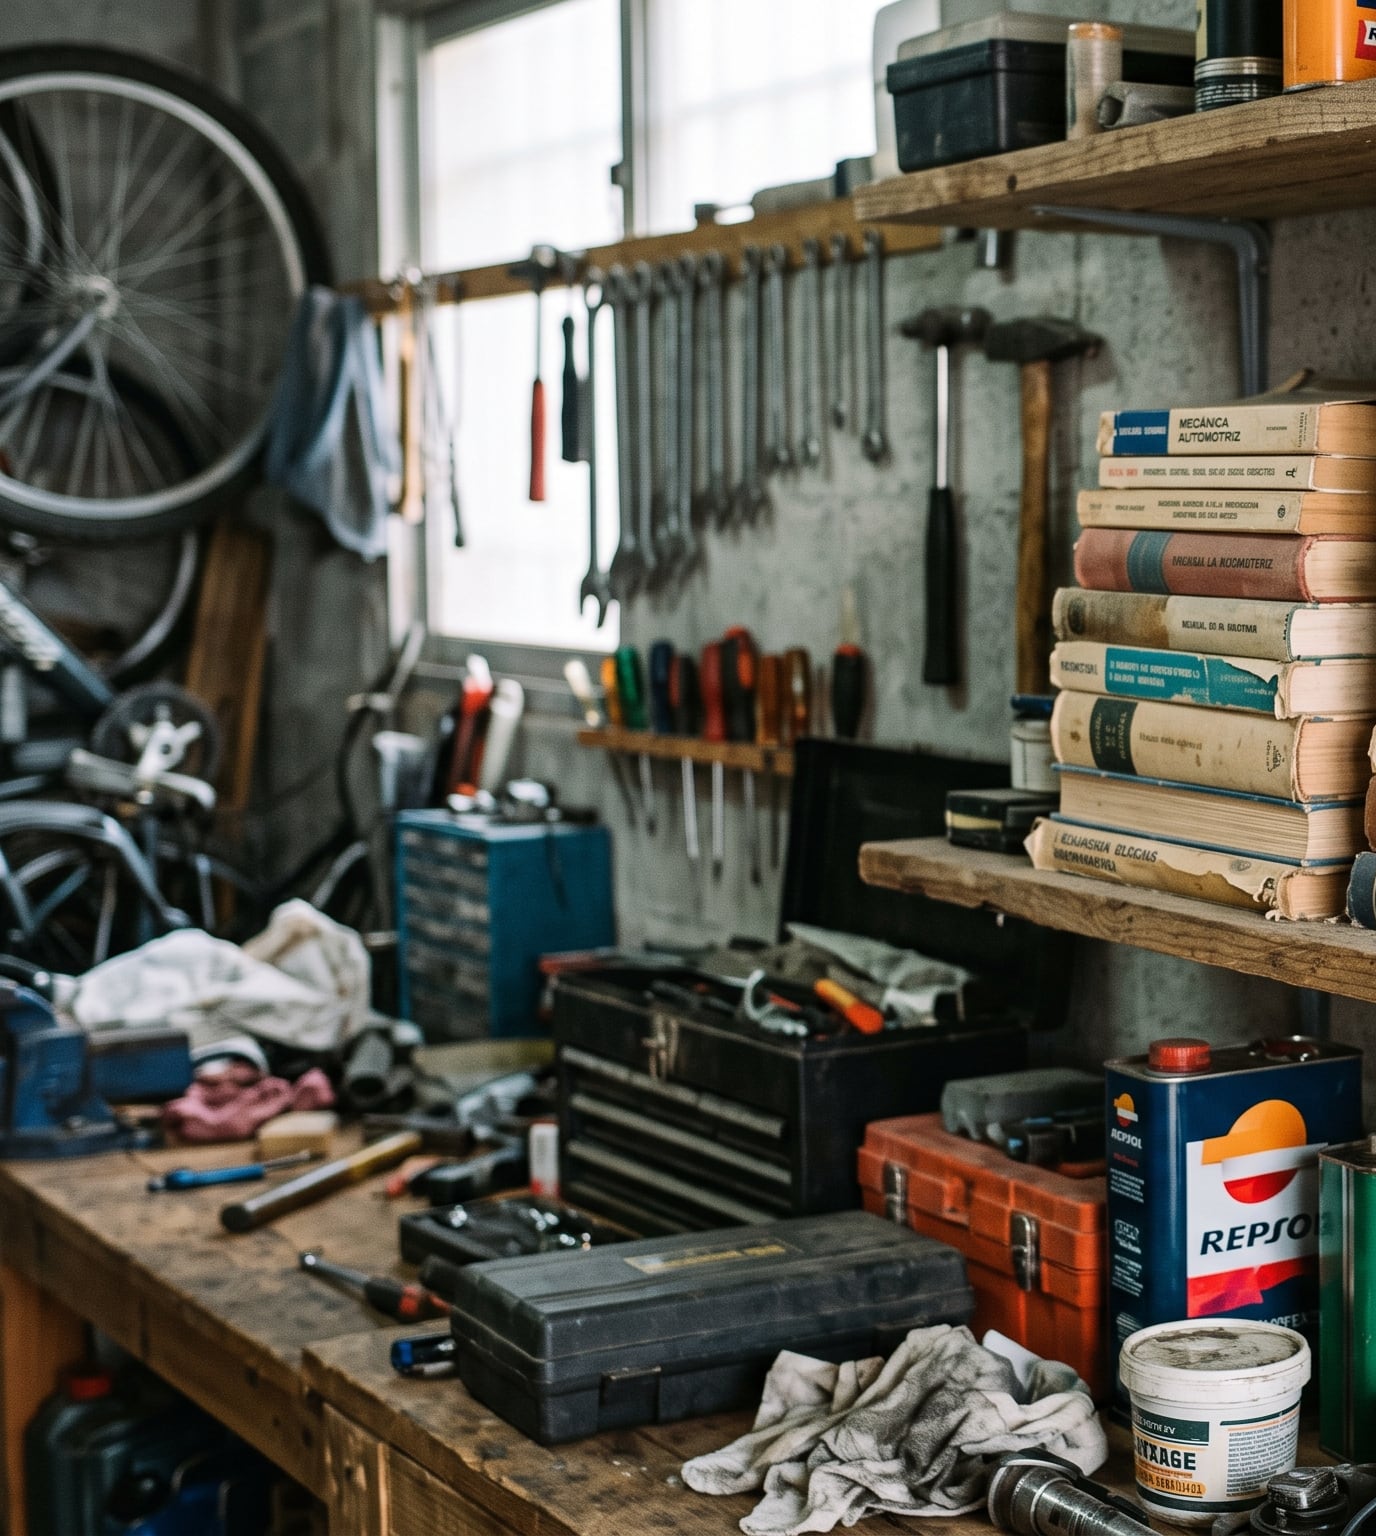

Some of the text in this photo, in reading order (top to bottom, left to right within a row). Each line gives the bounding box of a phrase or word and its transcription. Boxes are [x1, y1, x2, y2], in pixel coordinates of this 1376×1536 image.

[1179, 416, 1229, 429] MECÁNICA
[1178, 431, 1241, 443] AUTOMOTRIZ
[1200, 1212, 1320, 1255] REPSO
